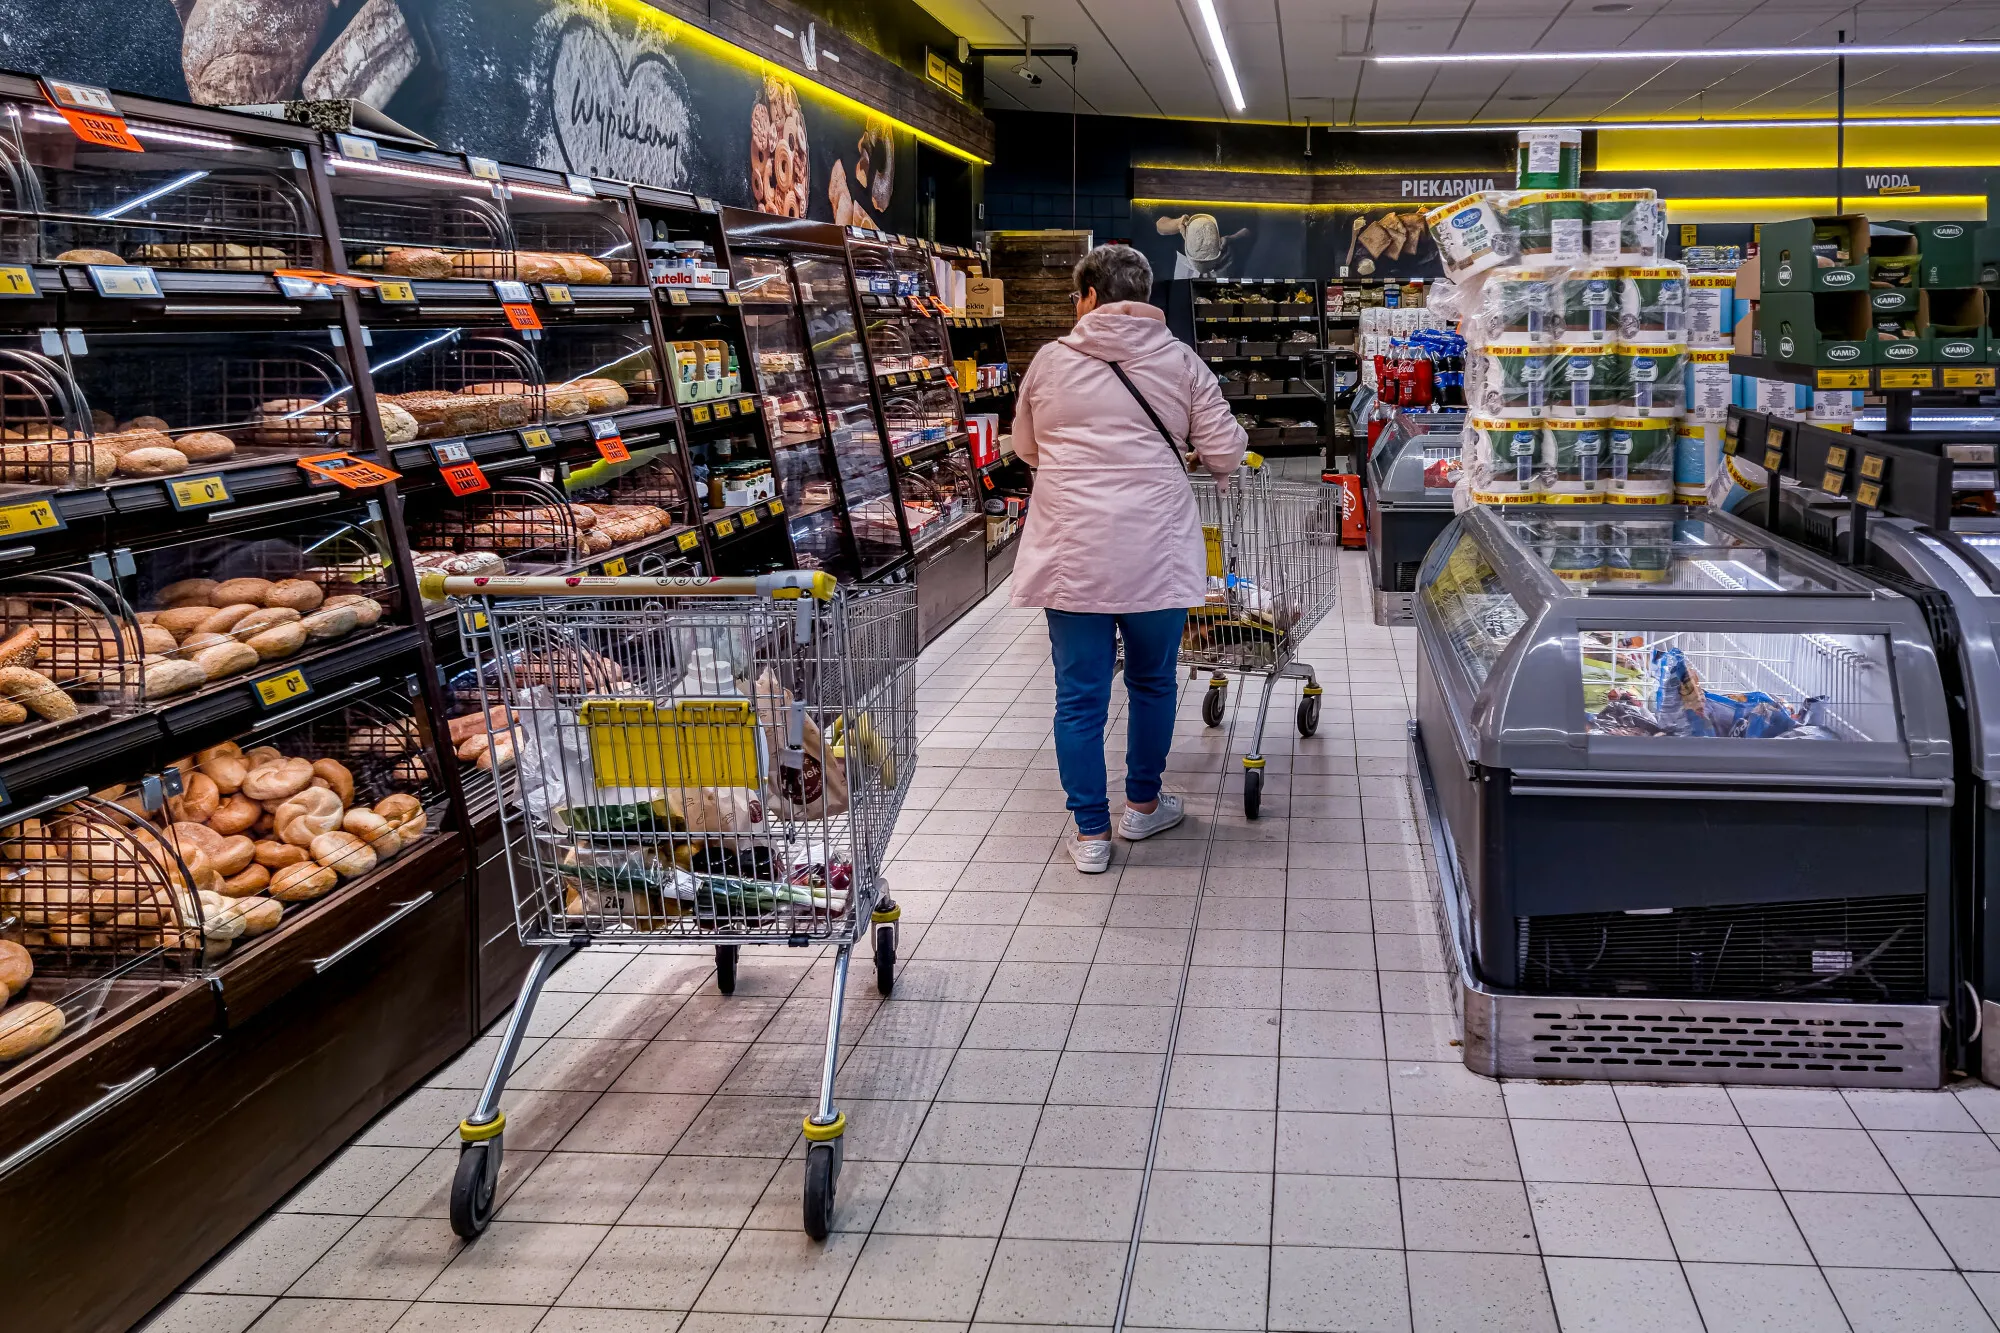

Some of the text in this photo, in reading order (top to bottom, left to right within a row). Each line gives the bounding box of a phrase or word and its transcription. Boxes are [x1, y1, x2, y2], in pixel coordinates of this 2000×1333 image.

[77, 116, 120, 133] TERAZ
[87, 129, 128, 145] TANIEJ
[1401, 178, 1496, 197] PIEKARNIA
[1865, 174, 1910, 189] WODA
[652, 272, 692, 285] nutella
[1877, 296, 1902, 304] KAMIS
[1831, 349, 1856, 357] KAMIS
[1945, 346, 1970, 354] KAMIS
[1696, 353, 1725, 362] PACK 3
[338, 467, 378, 479] TERAZ
[350, 473, 388, 485] TANIEJ
[451, 467, 474, 481] TERAZ
[456, 477, 480, 490] TANIEJ
[1343, 481, 1356, 520] Linde
